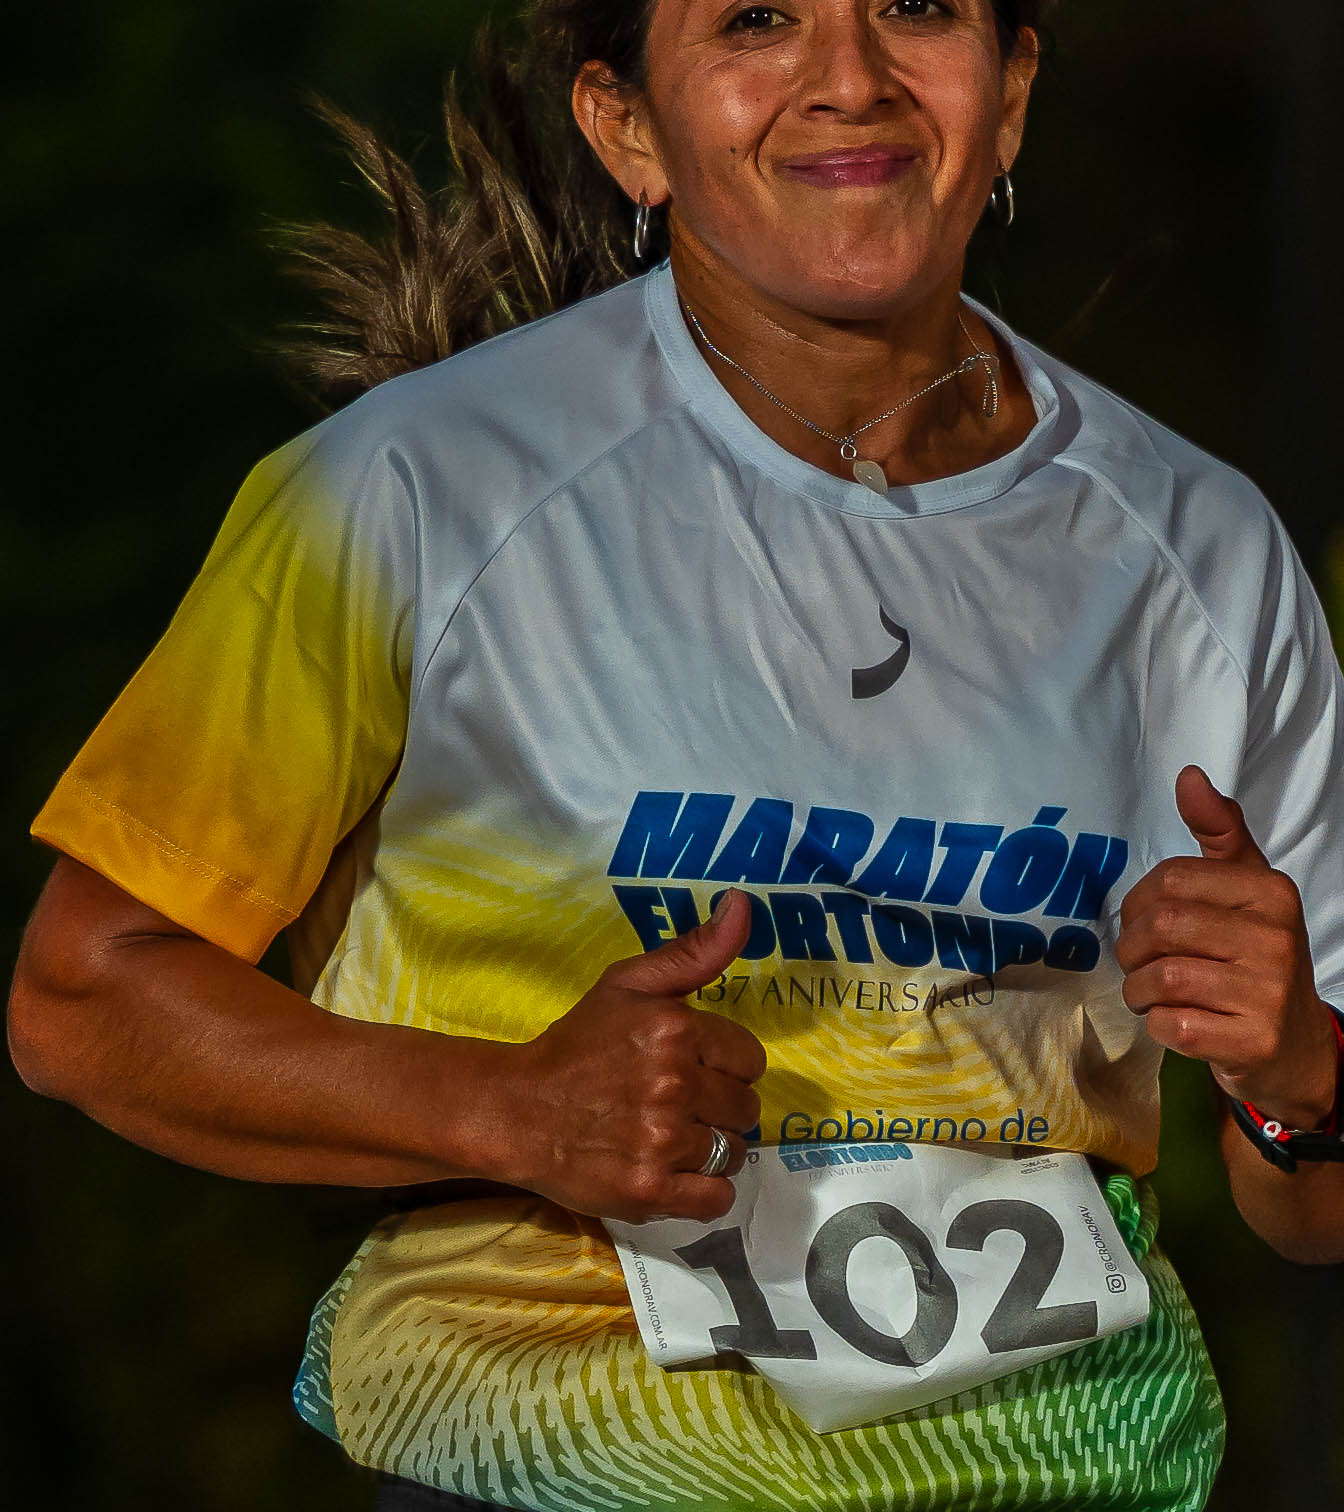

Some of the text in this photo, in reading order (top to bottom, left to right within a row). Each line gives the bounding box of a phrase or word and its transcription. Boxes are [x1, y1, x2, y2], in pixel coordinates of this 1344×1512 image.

[606, 790, 1129, 921] MARATÓN
[760, 975, 995, 1013] ANIVERSARIO
[780, 1108, 1049, 1143] Gobierno de
[1078, 1205, 1118, 1272] @CRONORAV
[673, 1198, 1098, 1368] 102
